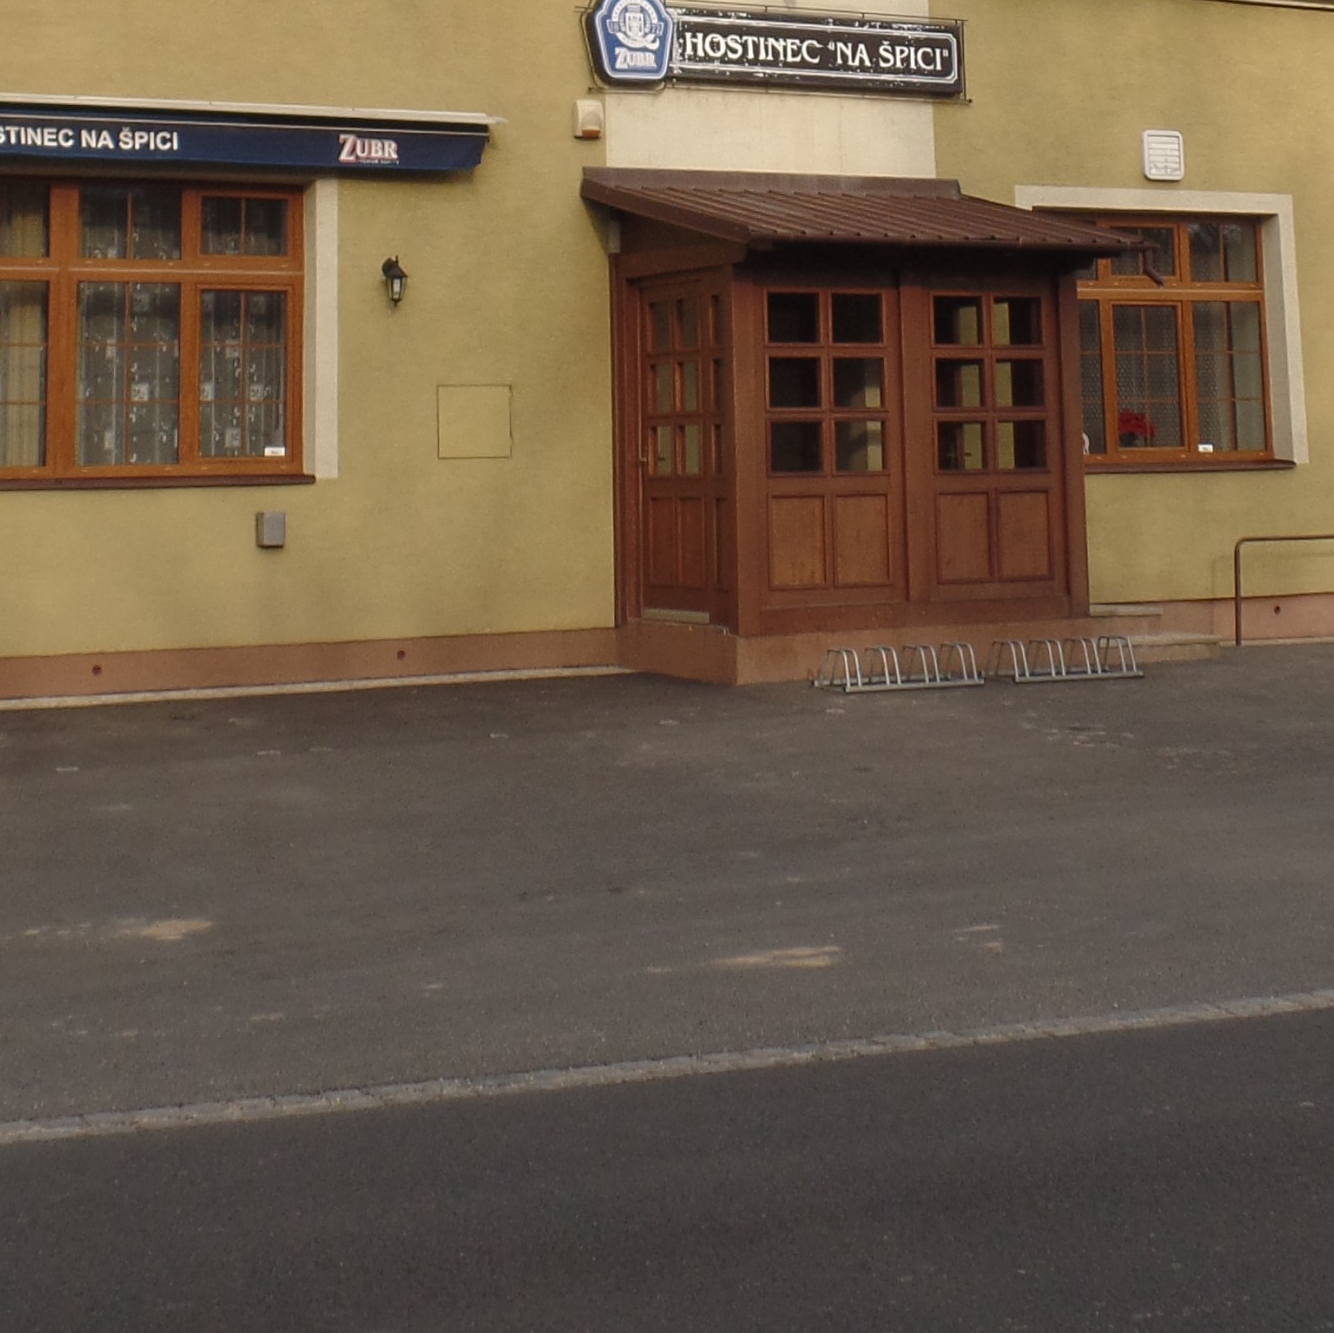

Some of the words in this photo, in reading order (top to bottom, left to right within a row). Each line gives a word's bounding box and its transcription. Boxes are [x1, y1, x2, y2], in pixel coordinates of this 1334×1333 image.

[685, 32, 824, 64] HOSTINEC
[80, 129, 114, 149] NA
[118, 126, 179, 151] ŠPICI
[338, 133, 398, 163] ZUBR
